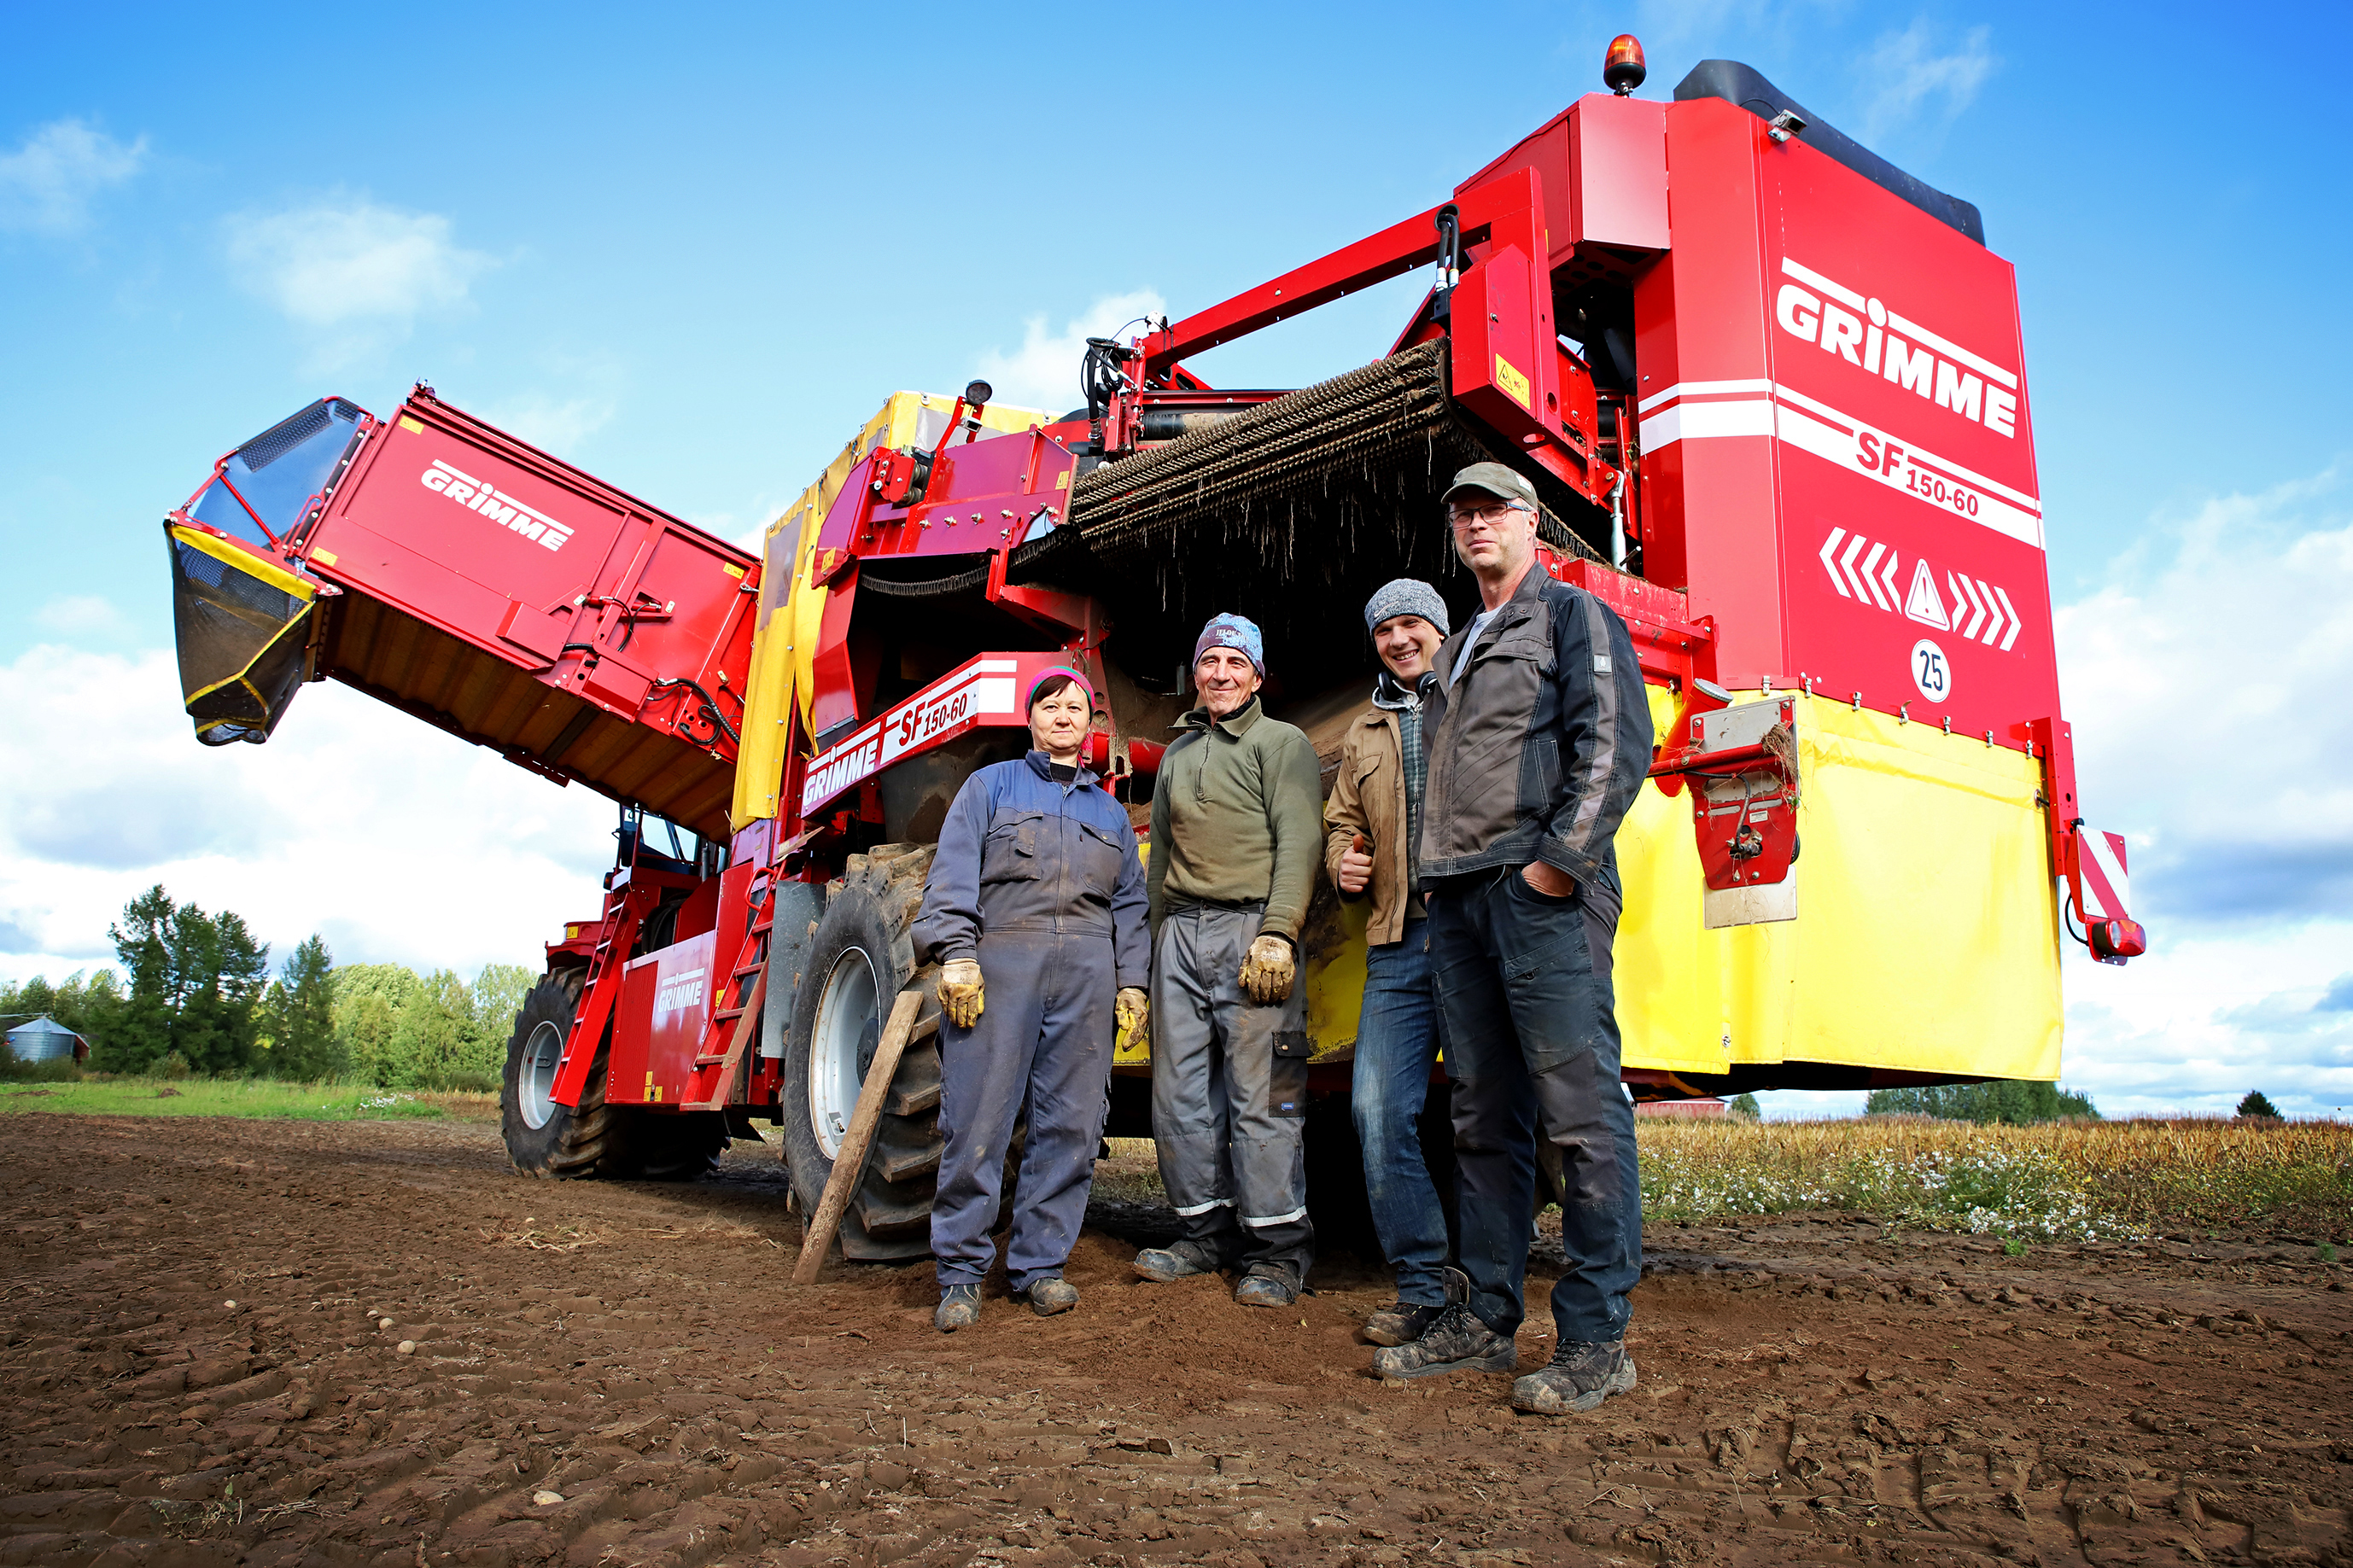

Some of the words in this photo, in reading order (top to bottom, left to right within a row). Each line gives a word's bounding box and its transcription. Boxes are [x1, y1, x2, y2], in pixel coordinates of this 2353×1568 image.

[1777, 283, 2016, 439] GRIMME
[1856, 432, 1904, 477] SF
[1906, 469, 1978, 516] 150-60
[421, 469, 569, 552] GRIMME
[1919, 650, 1942, 691] 25
[899, 701, 926, 747] SF
[923, 692, 967, 737] 150-60
[803, 738, 879, 807] GRIMME
[658, 972, 703, 1012] GRIMME
